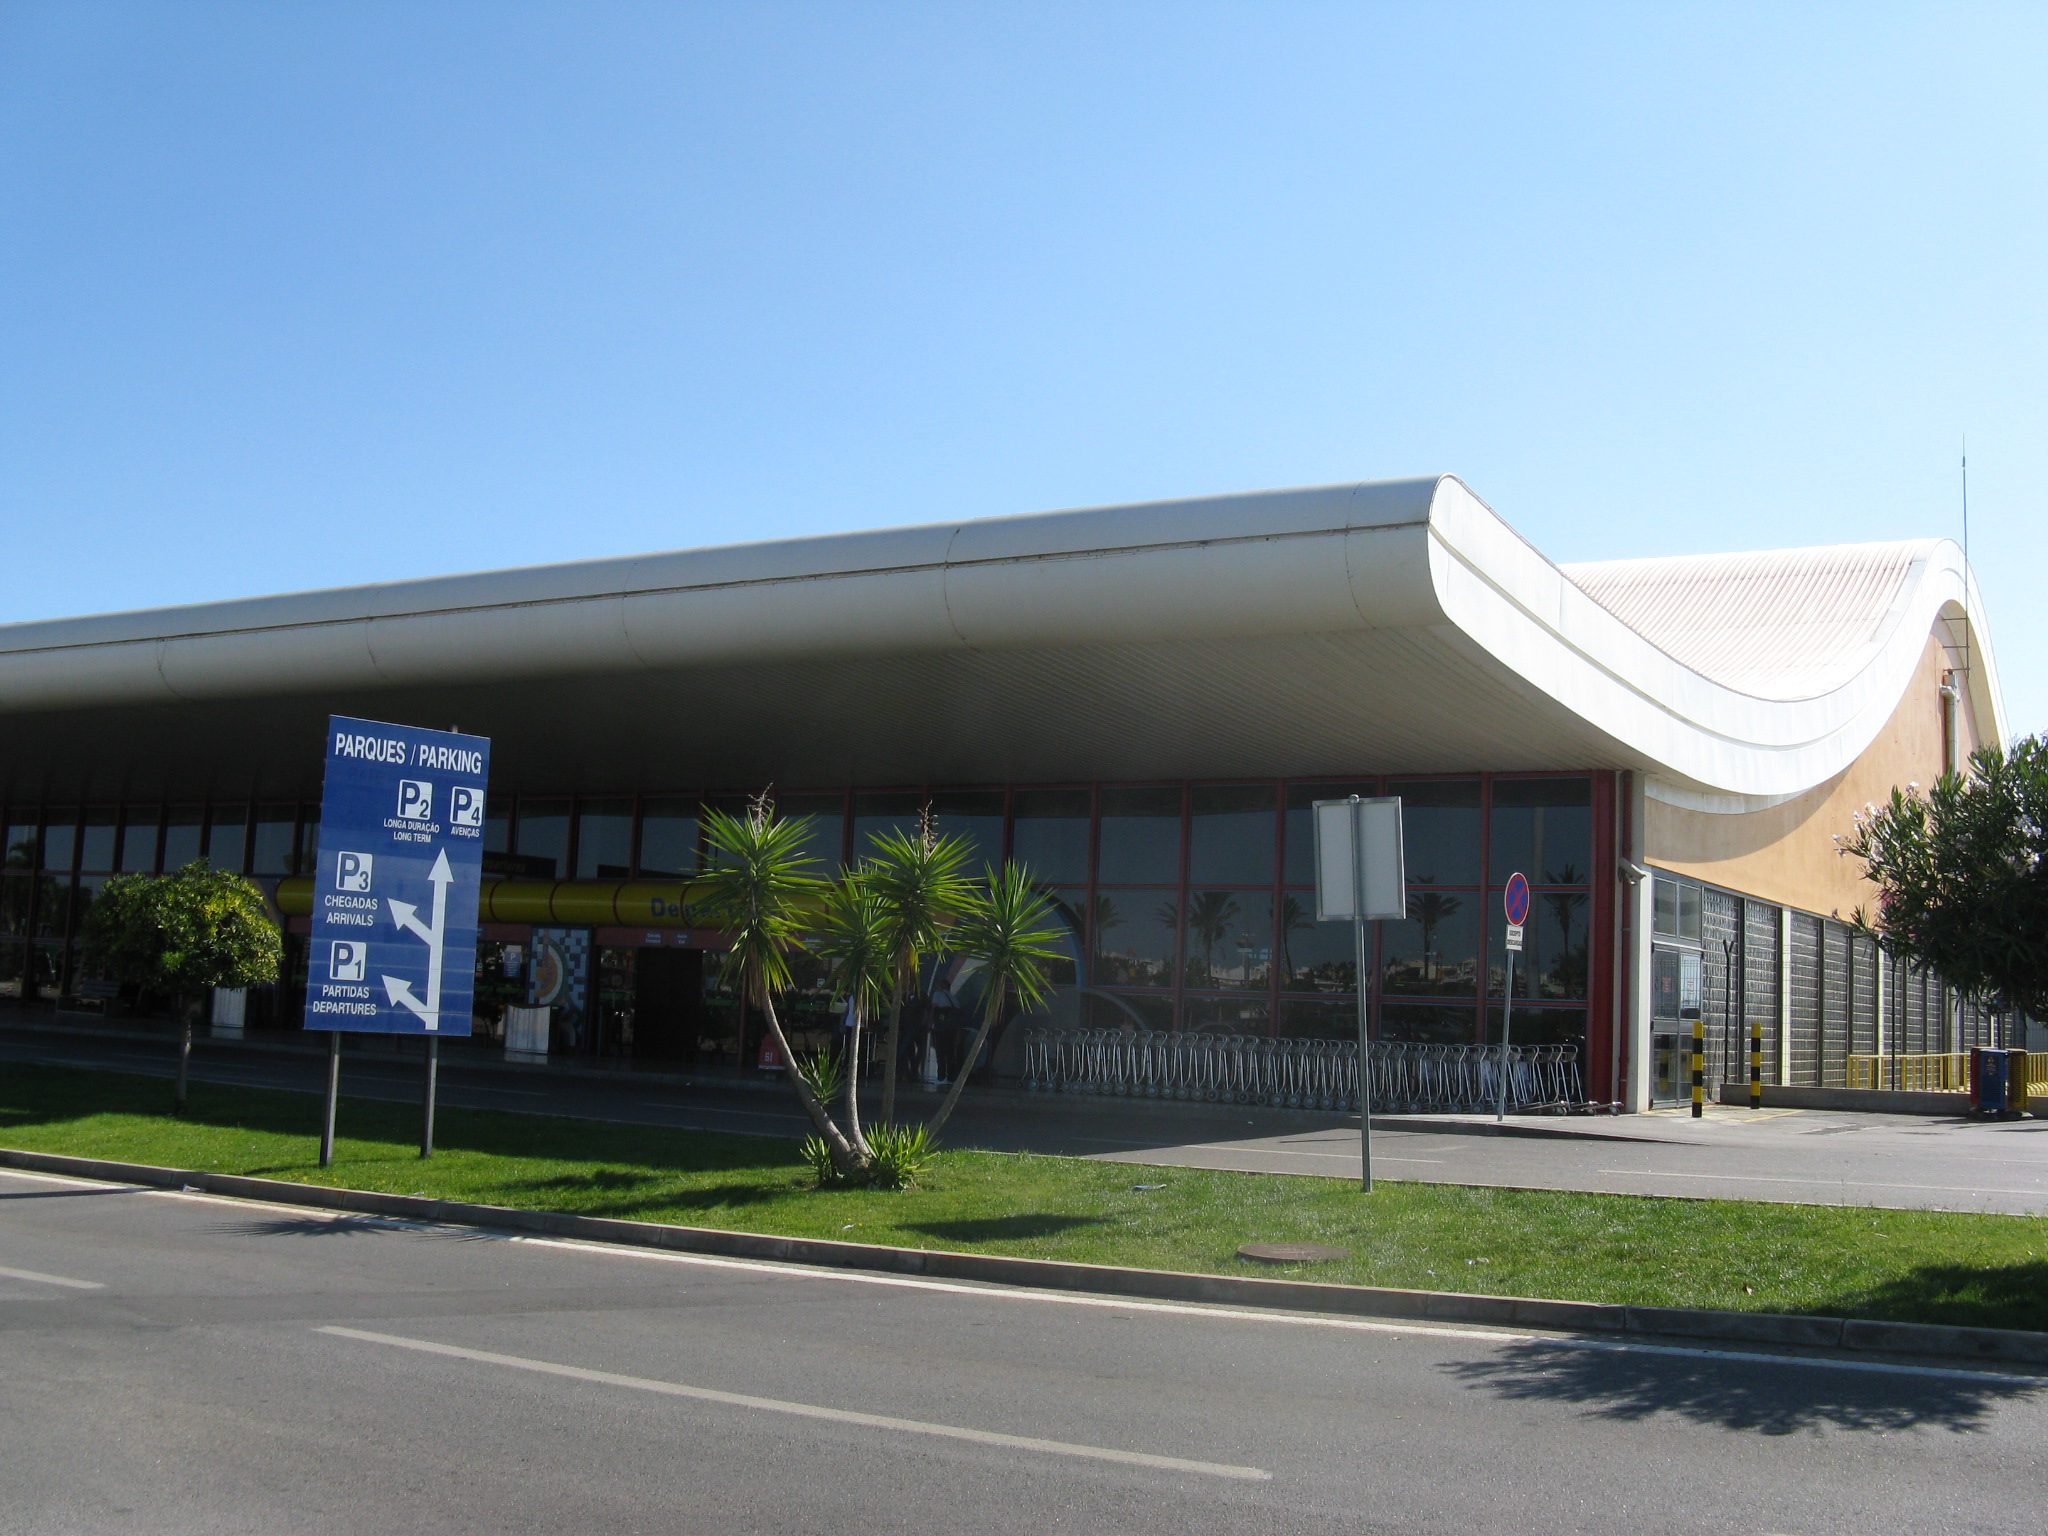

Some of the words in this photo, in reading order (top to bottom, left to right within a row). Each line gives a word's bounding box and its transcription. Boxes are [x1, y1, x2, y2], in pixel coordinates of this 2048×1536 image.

[335, 733, 405, 764] PARQUES
[419, 745, 481, 774] PARKING
[400, 781, 429, 818] P2
[453, 788, 480, 824] P4
[384, 819, 406, 829] LONGA
[407, 820, 439, 834] DURAÇÃO
[451, 827, 479, 838] AVENÇAS
[394, 832, 411, 842] LONG
[414, 832, 431, 843] TERM
[339, 853, 369, 890] P3
[325, 895, 377, 910] CHEGADAS
[326, 912, 373, 926] ARRIVALS
[333, 943, 361, 979] P1
[323, 985, 369, 998] PARTIDAS
[313, 1001, 376, 1015] DEPARTURES
